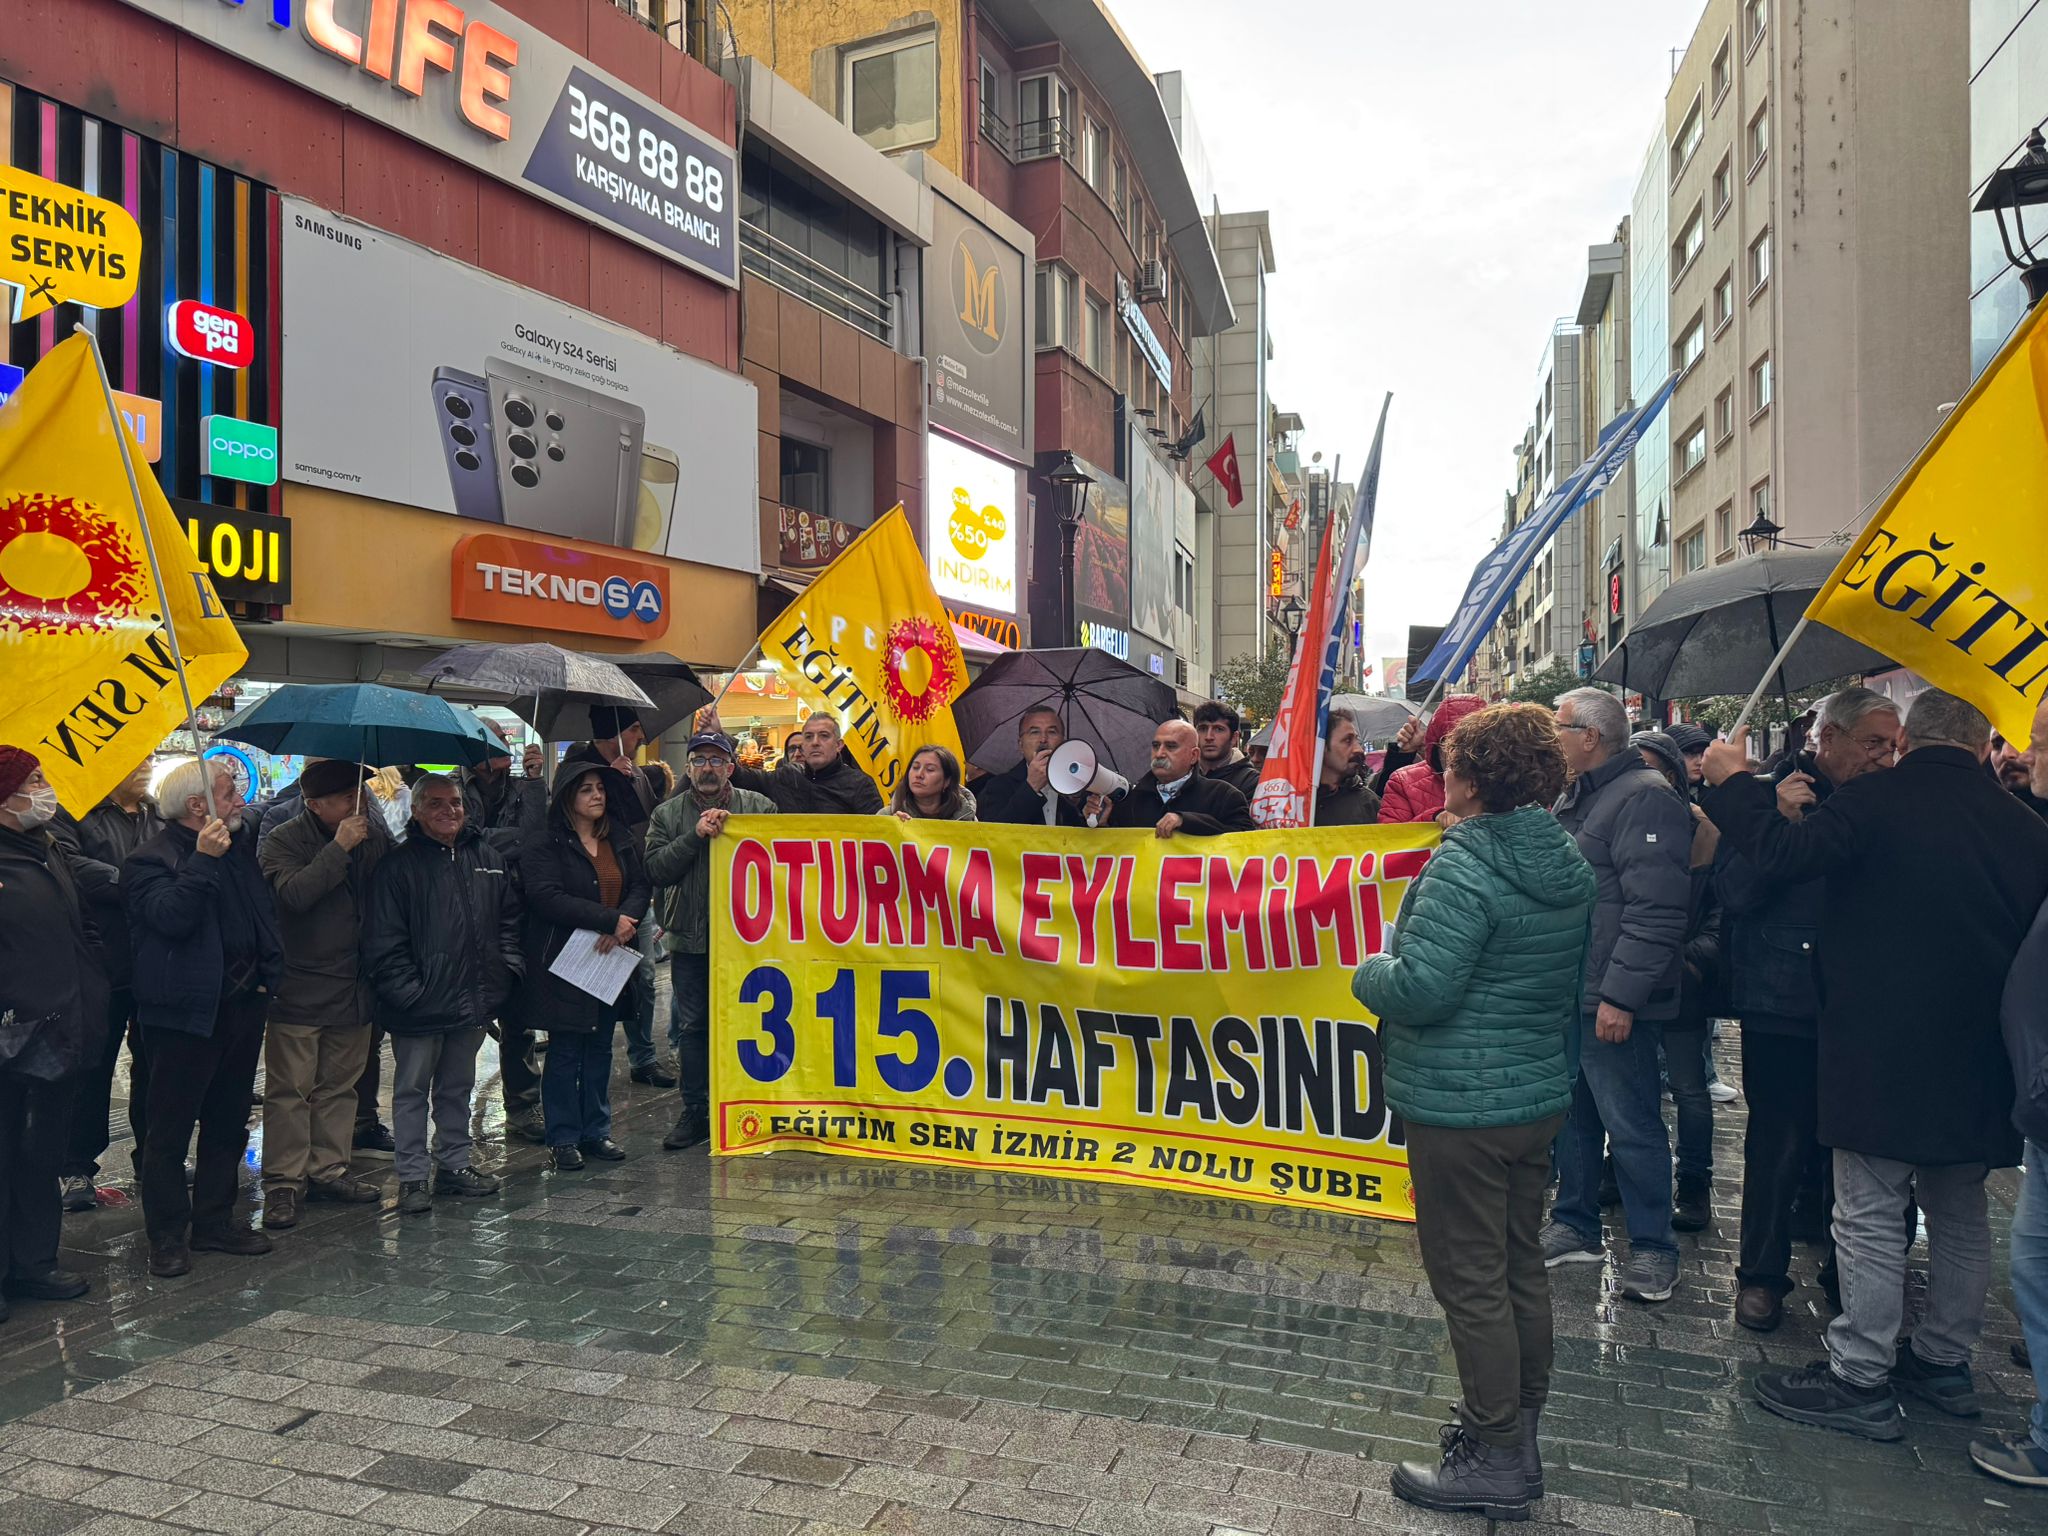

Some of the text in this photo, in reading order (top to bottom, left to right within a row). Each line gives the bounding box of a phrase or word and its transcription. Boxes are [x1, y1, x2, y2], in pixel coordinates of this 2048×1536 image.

[568, 84, 724, 213] 368 88 88
[575, 153, 720, 249] KARŞIYAKA BRANCH
[10, 232, 127, 280] SERVİS
[295, 214, 362, 251] SAMSUNG
[193, 309, 239, 337] gen
[206, 331, 239, 354] pa
[500, 341, 526, 358] Galaxy
[514, 323, 617, 373] Galaxy S24 Serisi
[212, 436, 275, 461] oppo
[294, 462, 363, 483] samsung.com/tr
[950, 519, 987, 549] %50
[476, 562, 660, 613] TEKNOSA
[1841, 528, 2048, 698] EĞİTİ
[1089, 621, 1129, 662] BARGELLO
[780, 622, 890, 761] EĞİTİM
[729, 838, 1005, 956] OTURMA
[736, 965, 976, 1099] 315.
[769, 1108, 896, 1144] EĞİTİM
[909, 1122, 979, 1152] SEN
[991, 1122, 1100, 1163] İZMİR
[1111, 1141, 1138, 1164] 2
[1149, 1145, 1255, 1184] NOLU
[1269, 1162, 1383, 1202] ŞUBE
